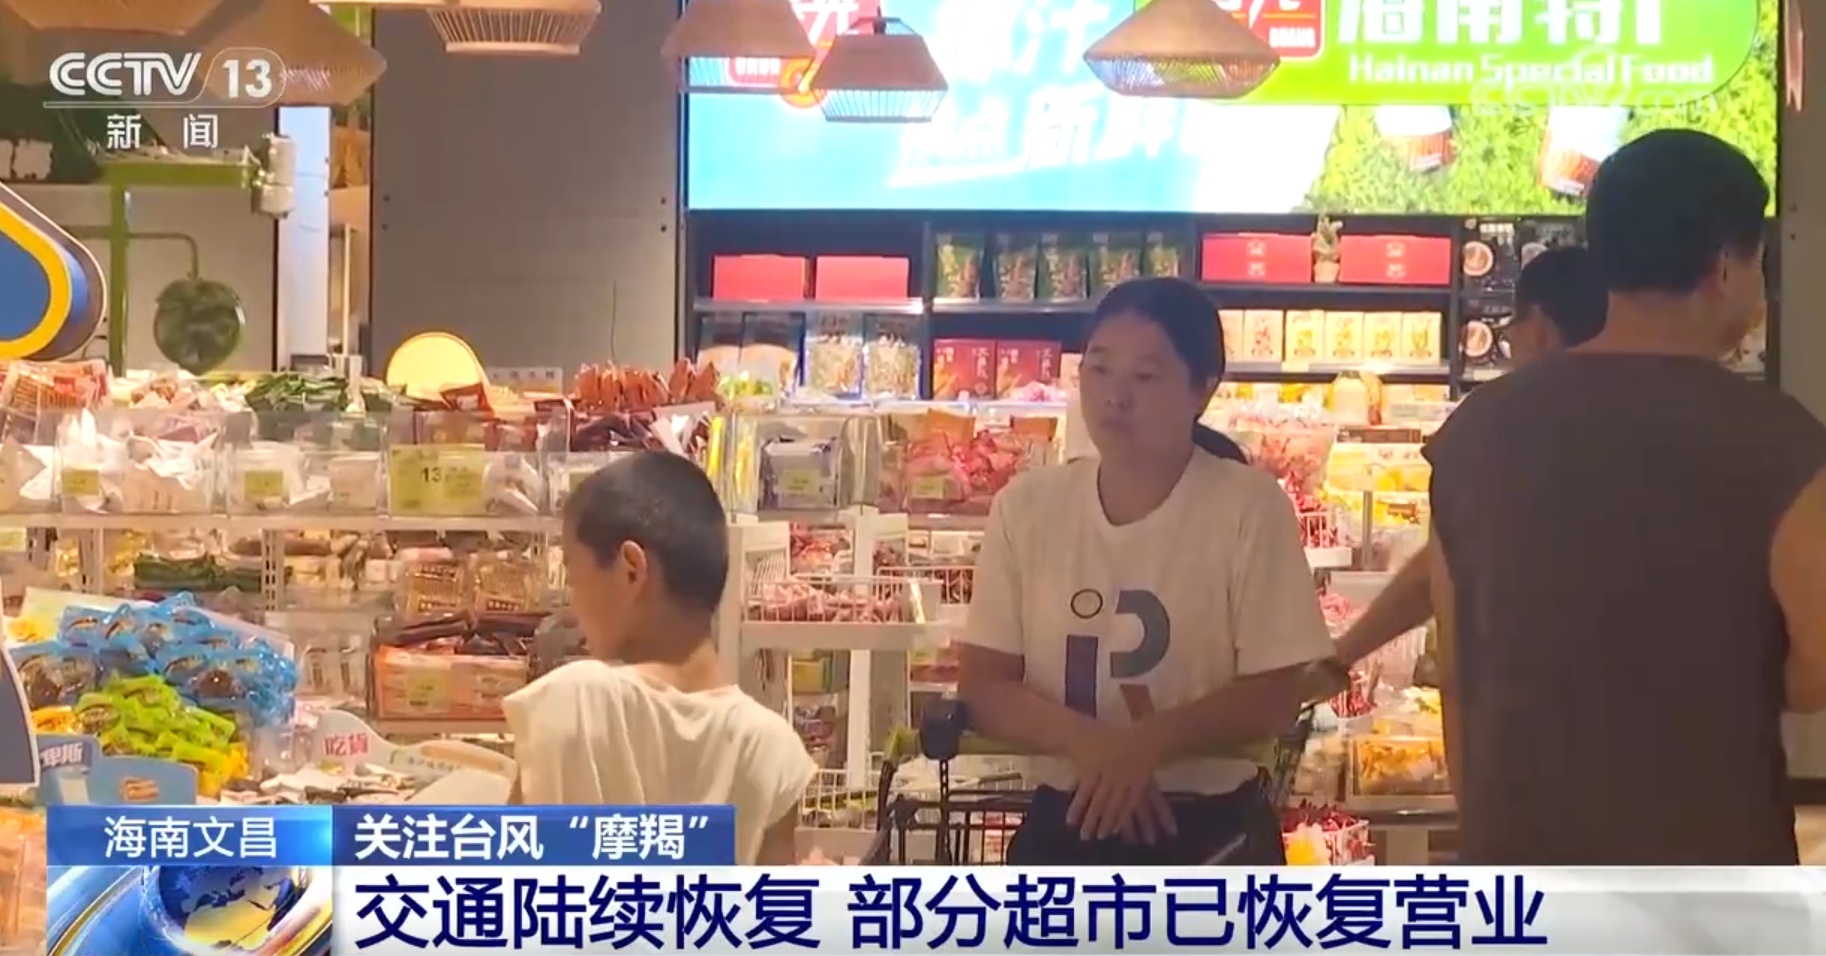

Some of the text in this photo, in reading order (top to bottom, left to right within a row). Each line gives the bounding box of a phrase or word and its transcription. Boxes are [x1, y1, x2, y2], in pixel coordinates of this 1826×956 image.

[1349, 53, 1715, 92] Hainan Special Food
